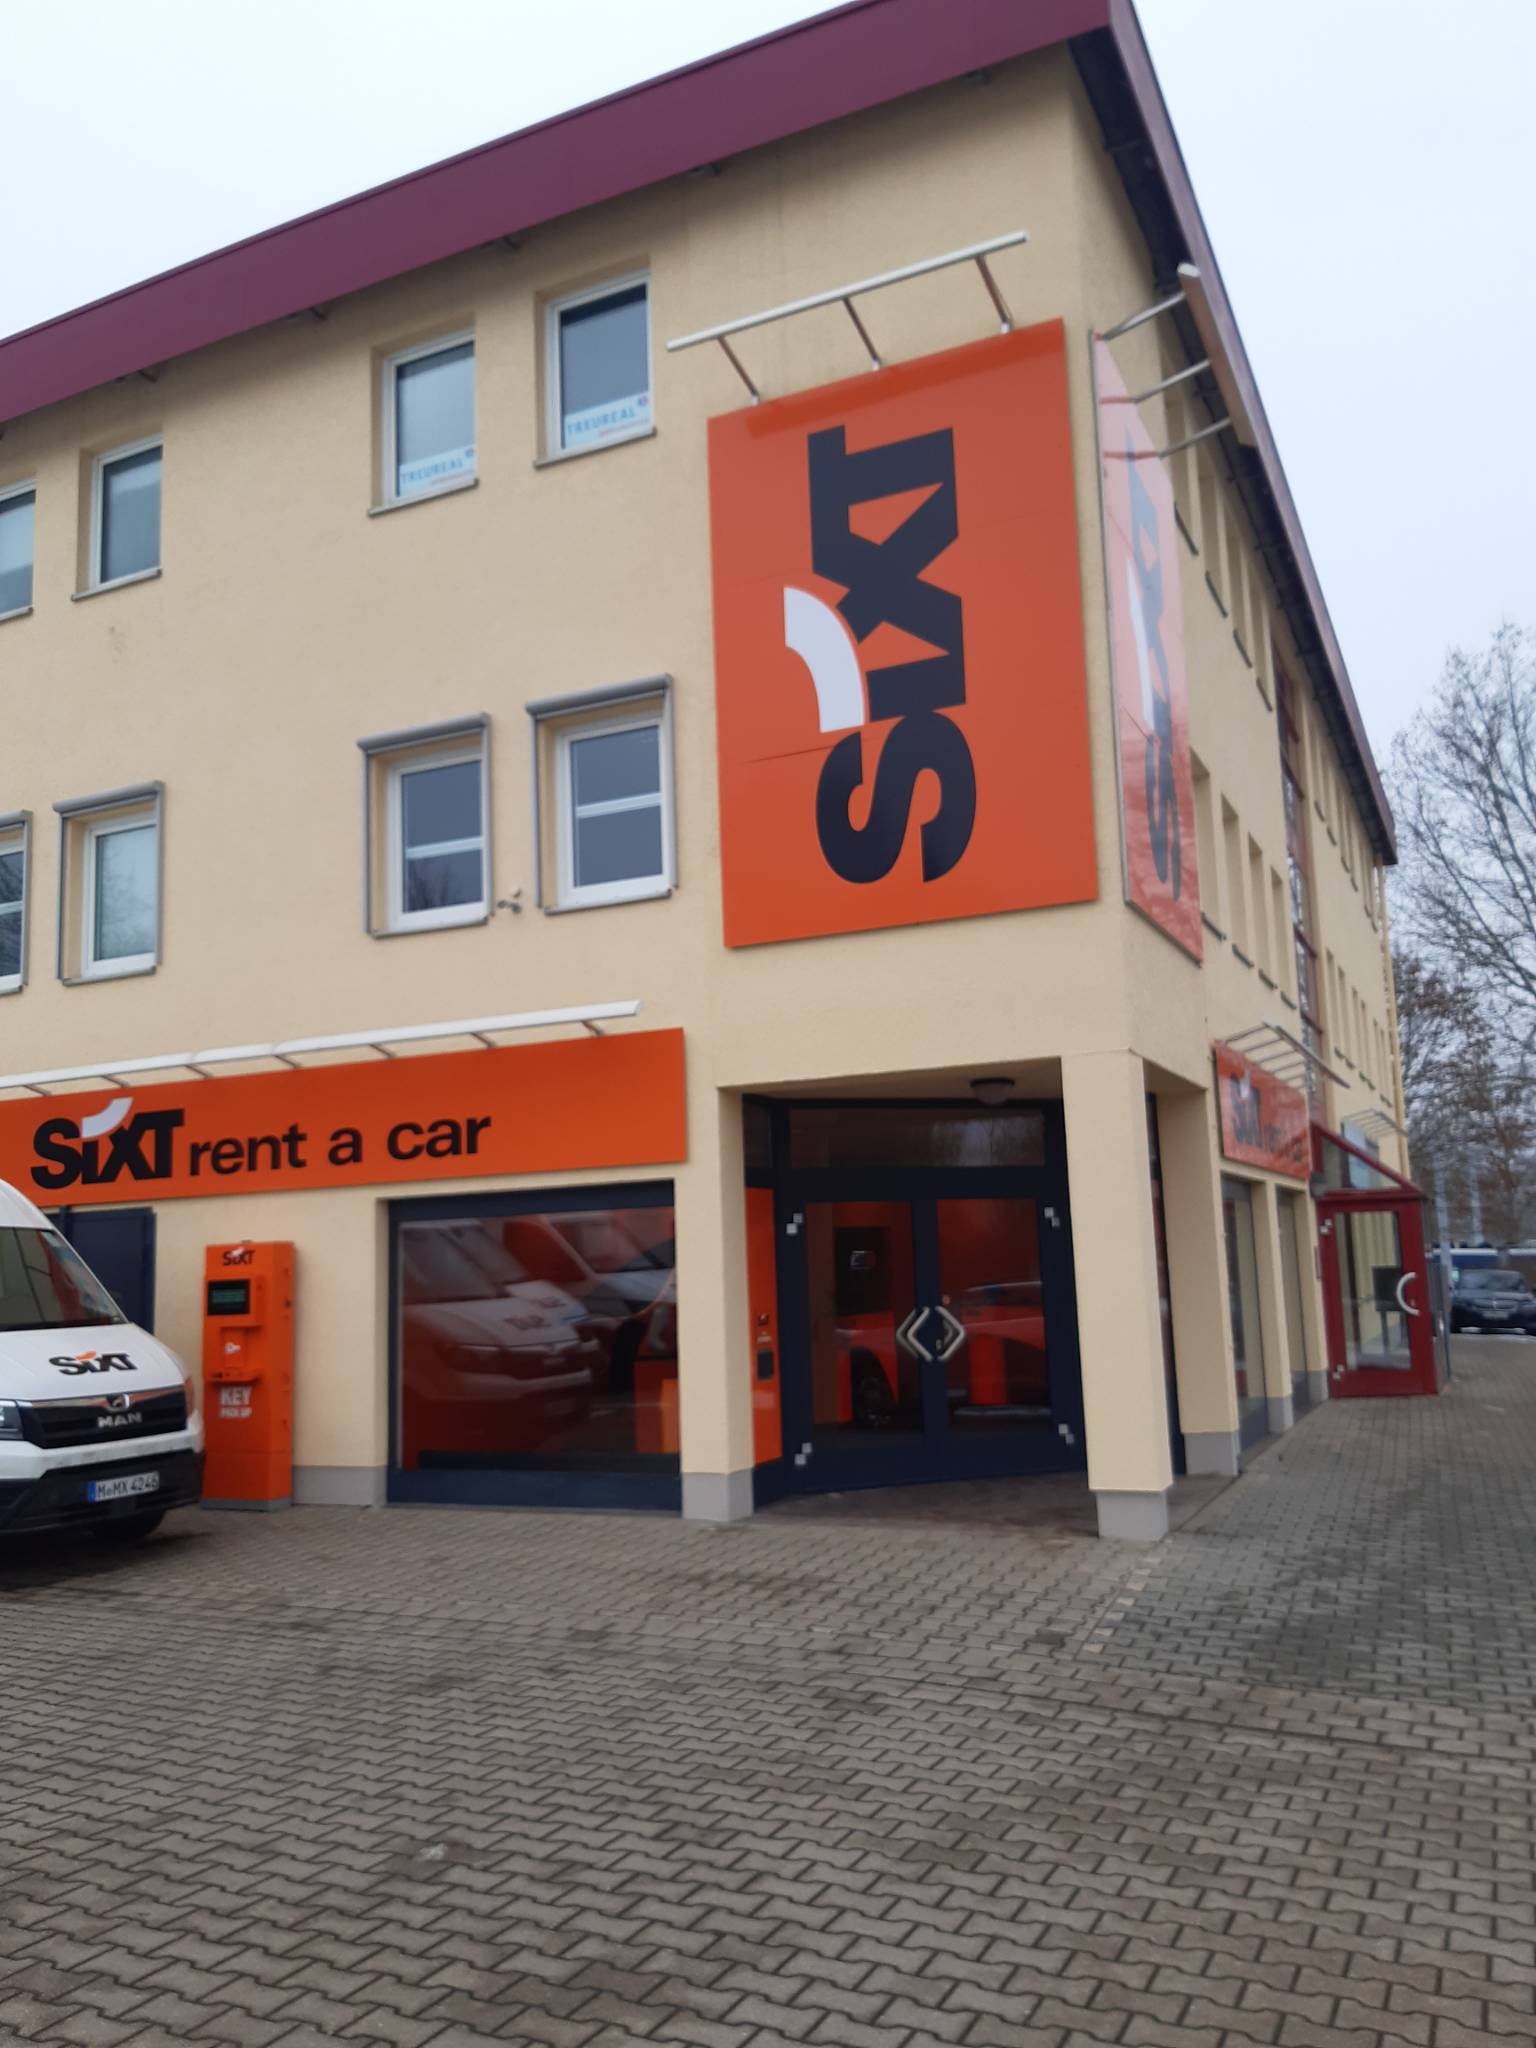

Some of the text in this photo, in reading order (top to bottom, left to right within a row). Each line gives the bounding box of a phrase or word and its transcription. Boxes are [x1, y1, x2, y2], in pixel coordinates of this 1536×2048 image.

[189, 1123, 307, 1177] rent
[328, 1127, 363, 1167] a
[387, 1116, 492, 1161] car
[219, 1386, 252, 1406] KEY
[97, 1412, 142, 1429] MAN
